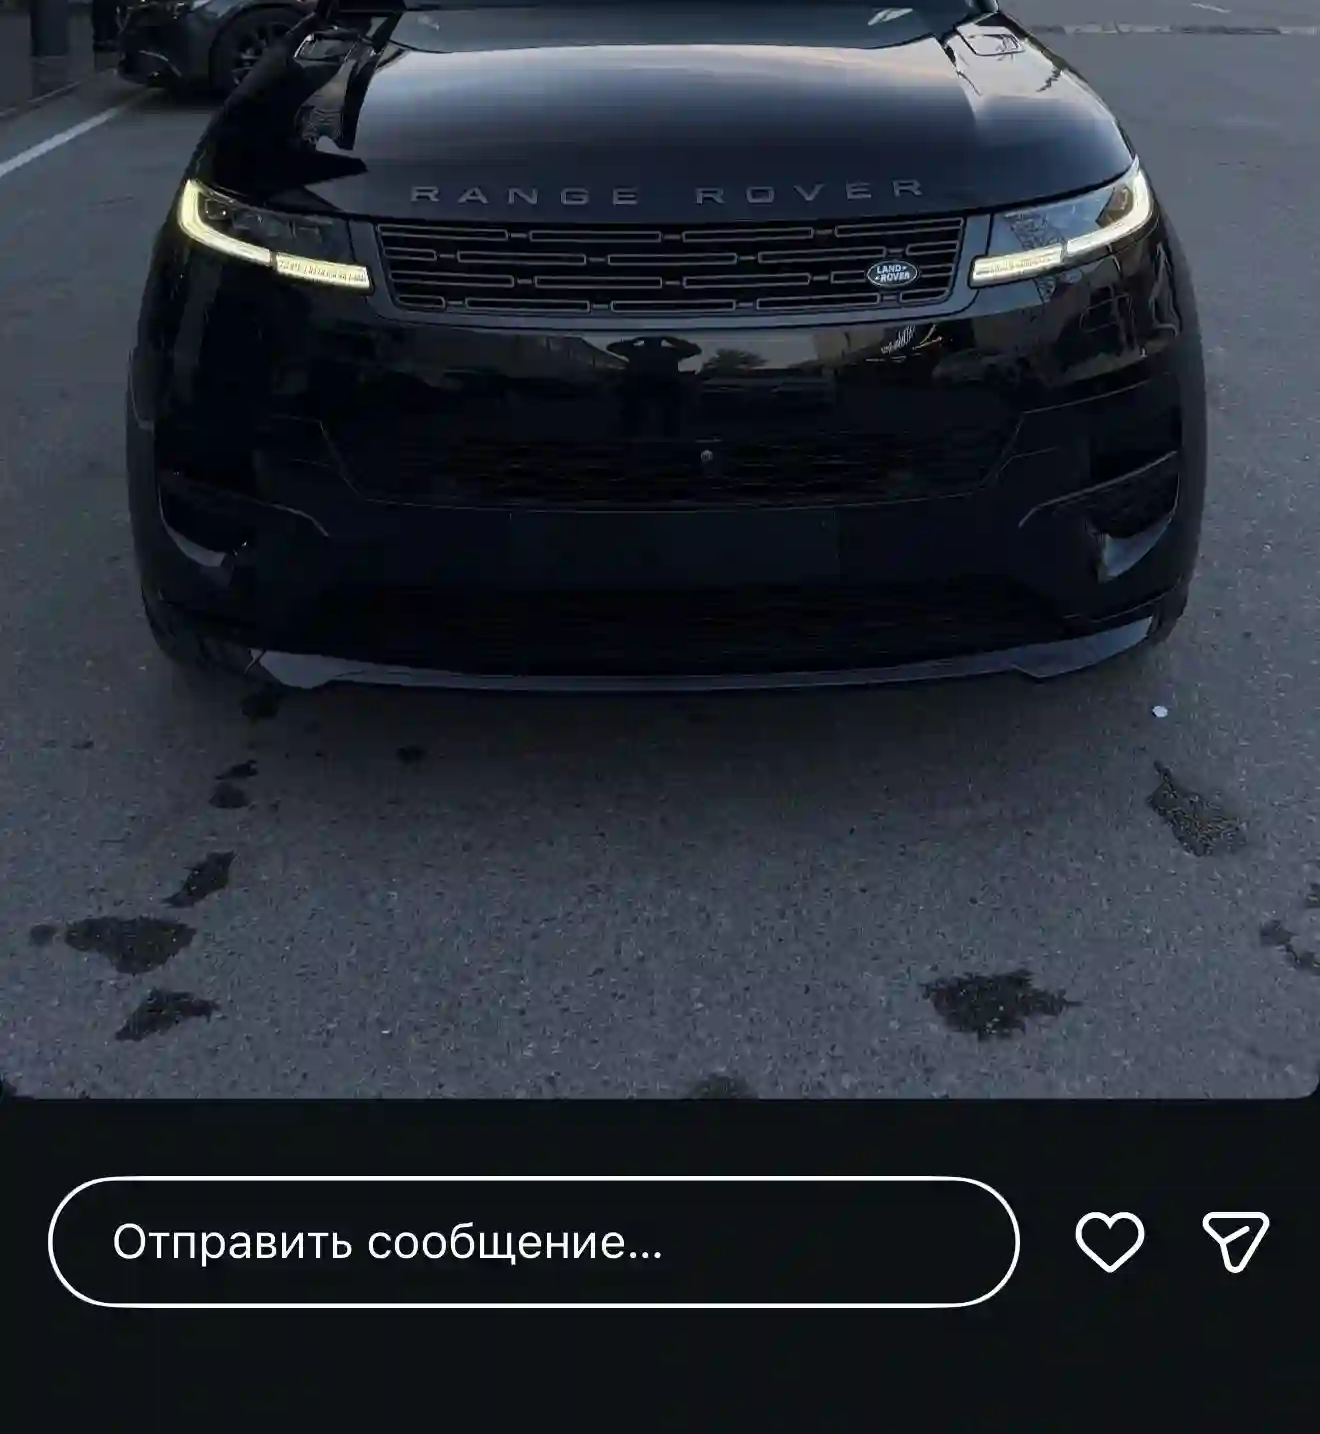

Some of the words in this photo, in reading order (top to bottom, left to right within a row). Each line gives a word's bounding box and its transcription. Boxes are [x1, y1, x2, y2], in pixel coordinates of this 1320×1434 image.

[411, 185, 638, 206] RANGE
[695, 179, 923, 204] ROVER
[876, 264, 902, 275] LAND
[880, 271, 910, 283] ROVER
